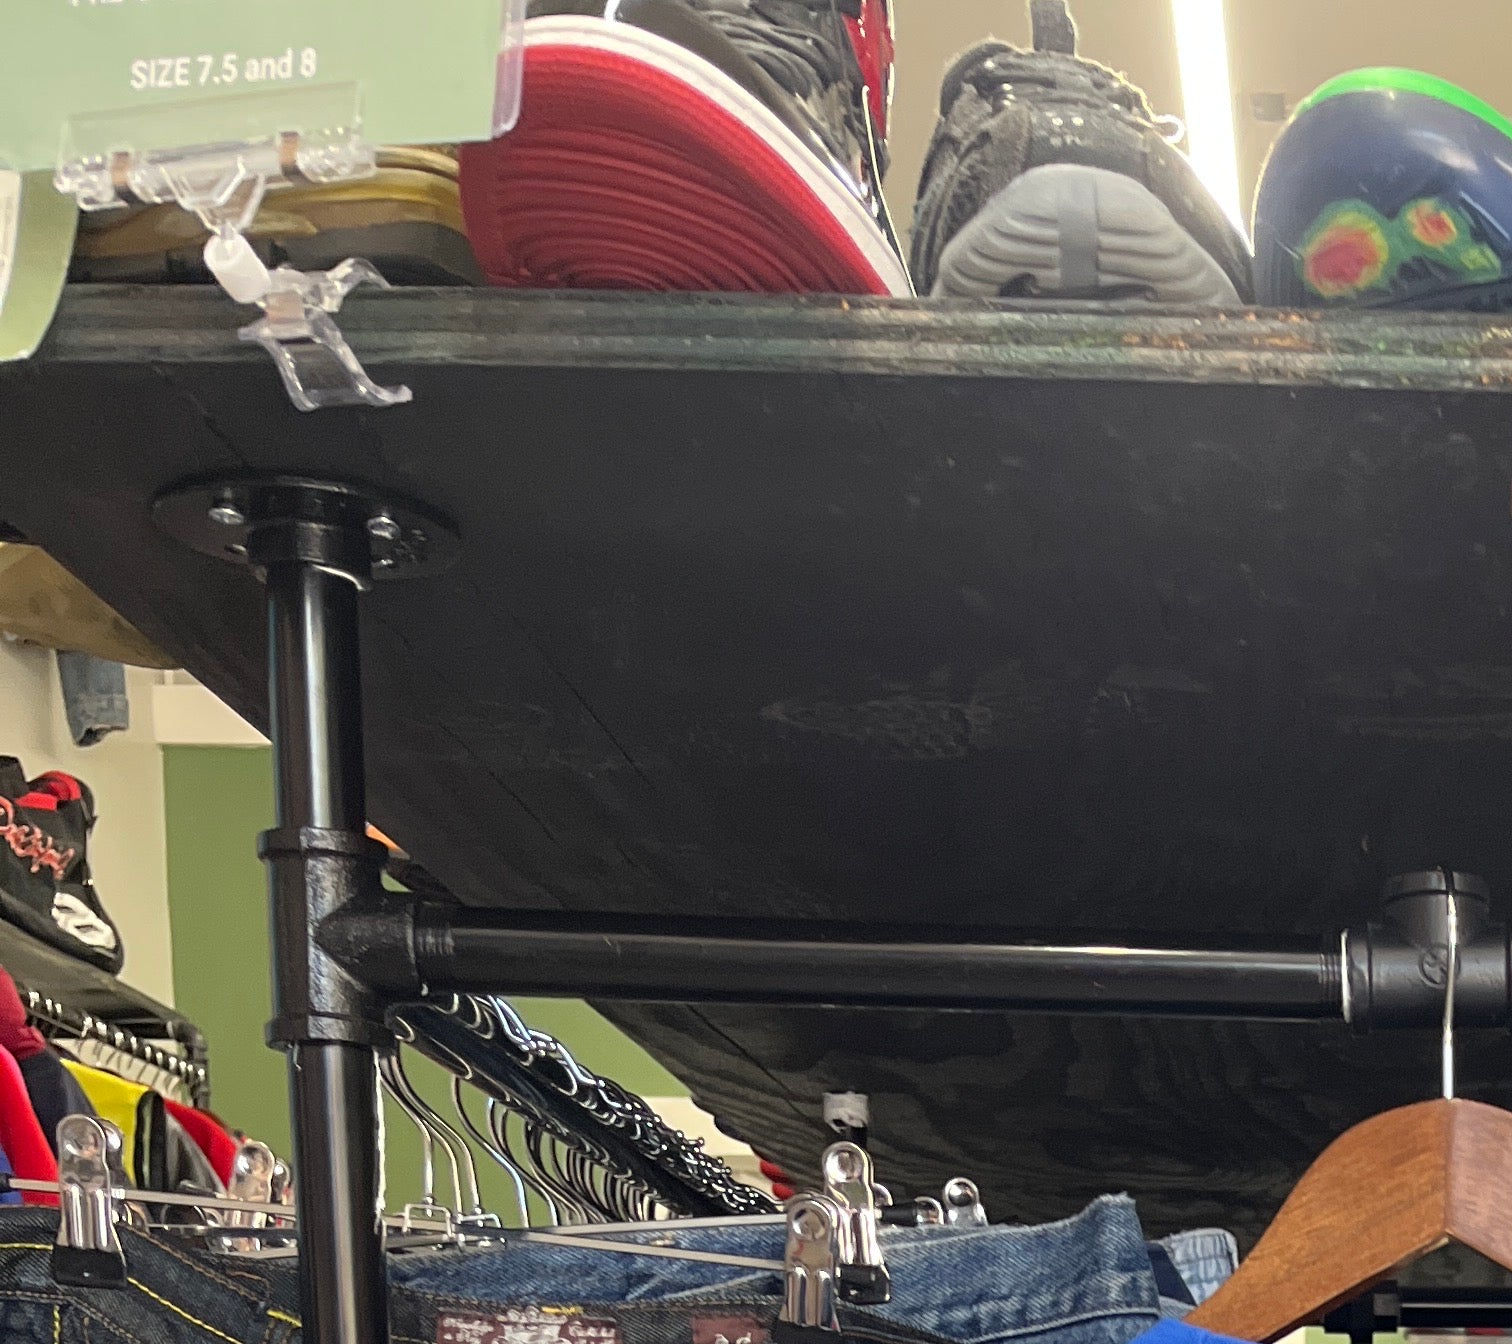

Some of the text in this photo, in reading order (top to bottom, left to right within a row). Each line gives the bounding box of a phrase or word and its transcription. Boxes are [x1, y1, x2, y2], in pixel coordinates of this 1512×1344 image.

[130, 47, 317, 90] SIZE 7.5 and 8
